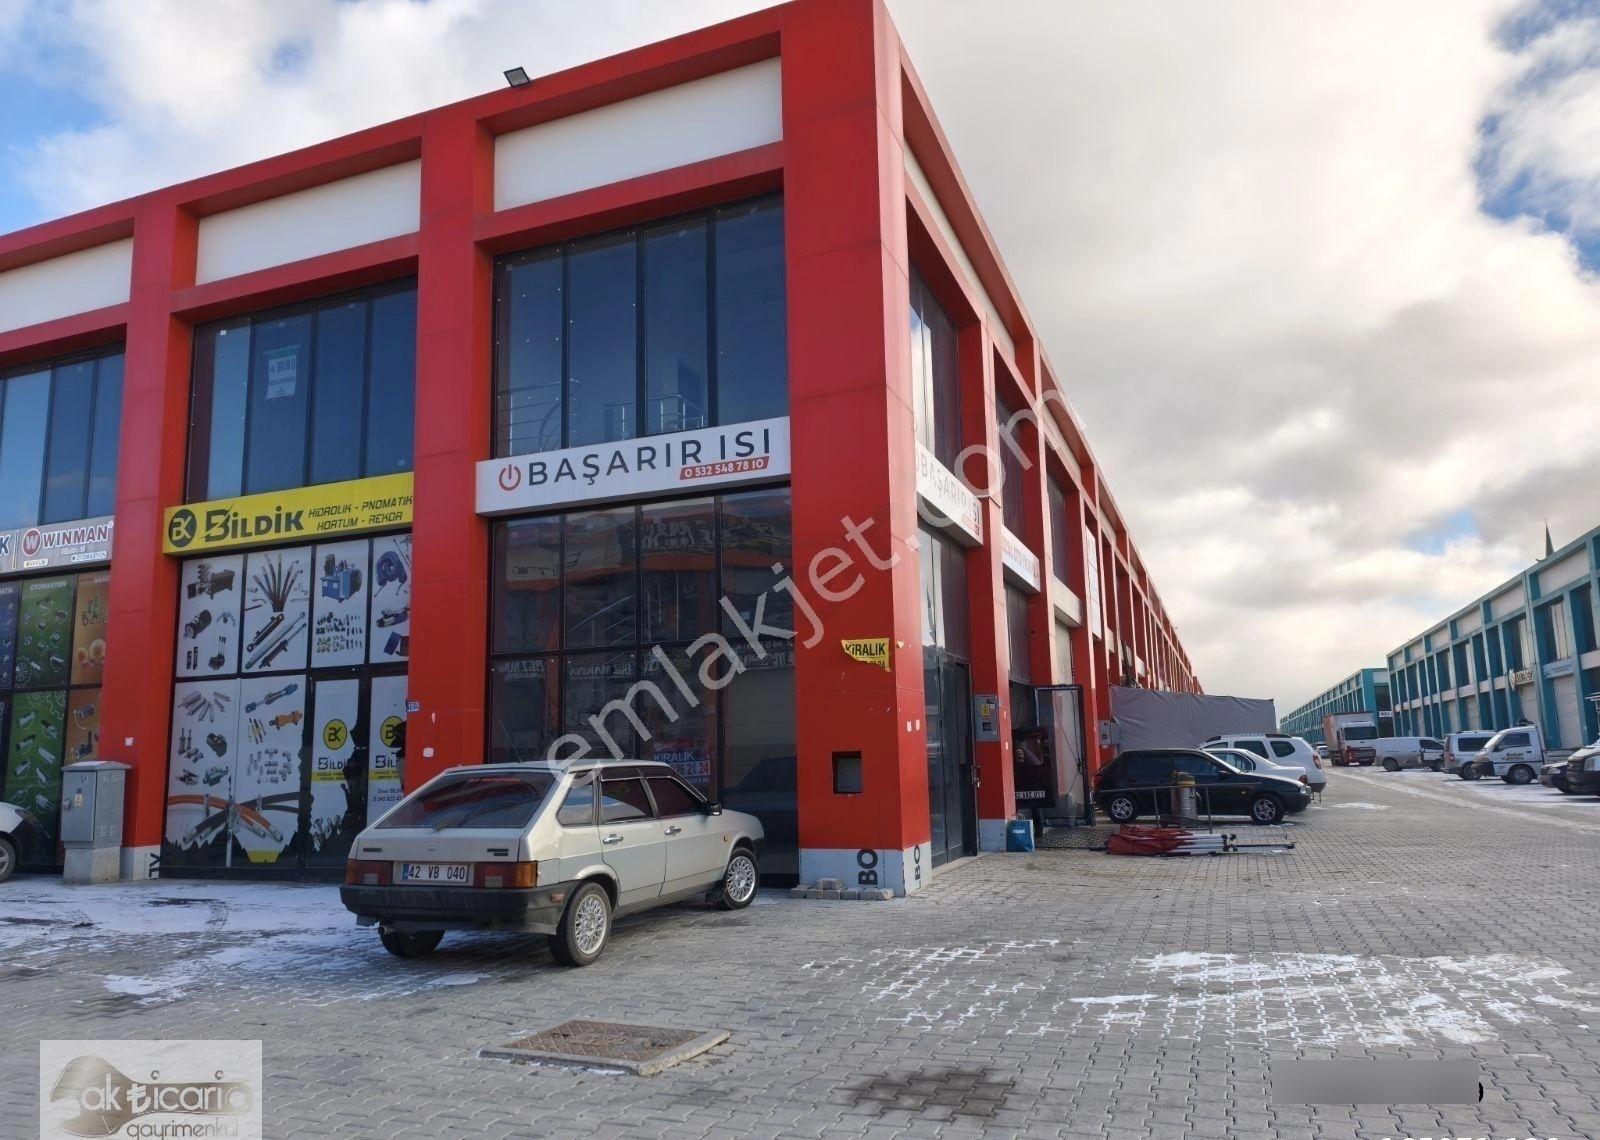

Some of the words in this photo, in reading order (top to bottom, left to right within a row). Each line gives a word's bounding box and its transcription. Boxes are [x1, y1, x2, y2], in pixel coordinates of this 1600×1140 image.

[528, 439, 702, 486] BAŞARIR
[720, 428, 770, 460] ISI
[695, 465, 712, 477] 532
[715, 463, 734, 475] 548
[736, 461, 749, 472] 78
[751, 458, 764, 470] 10
[43, 524, 110, 549] WINMAN
[408, 865, 421, 879] 42
[428, 865, 440, 879] VB
[446, 866, 465, 880] 040
[856, 849, 878, 885] BO
